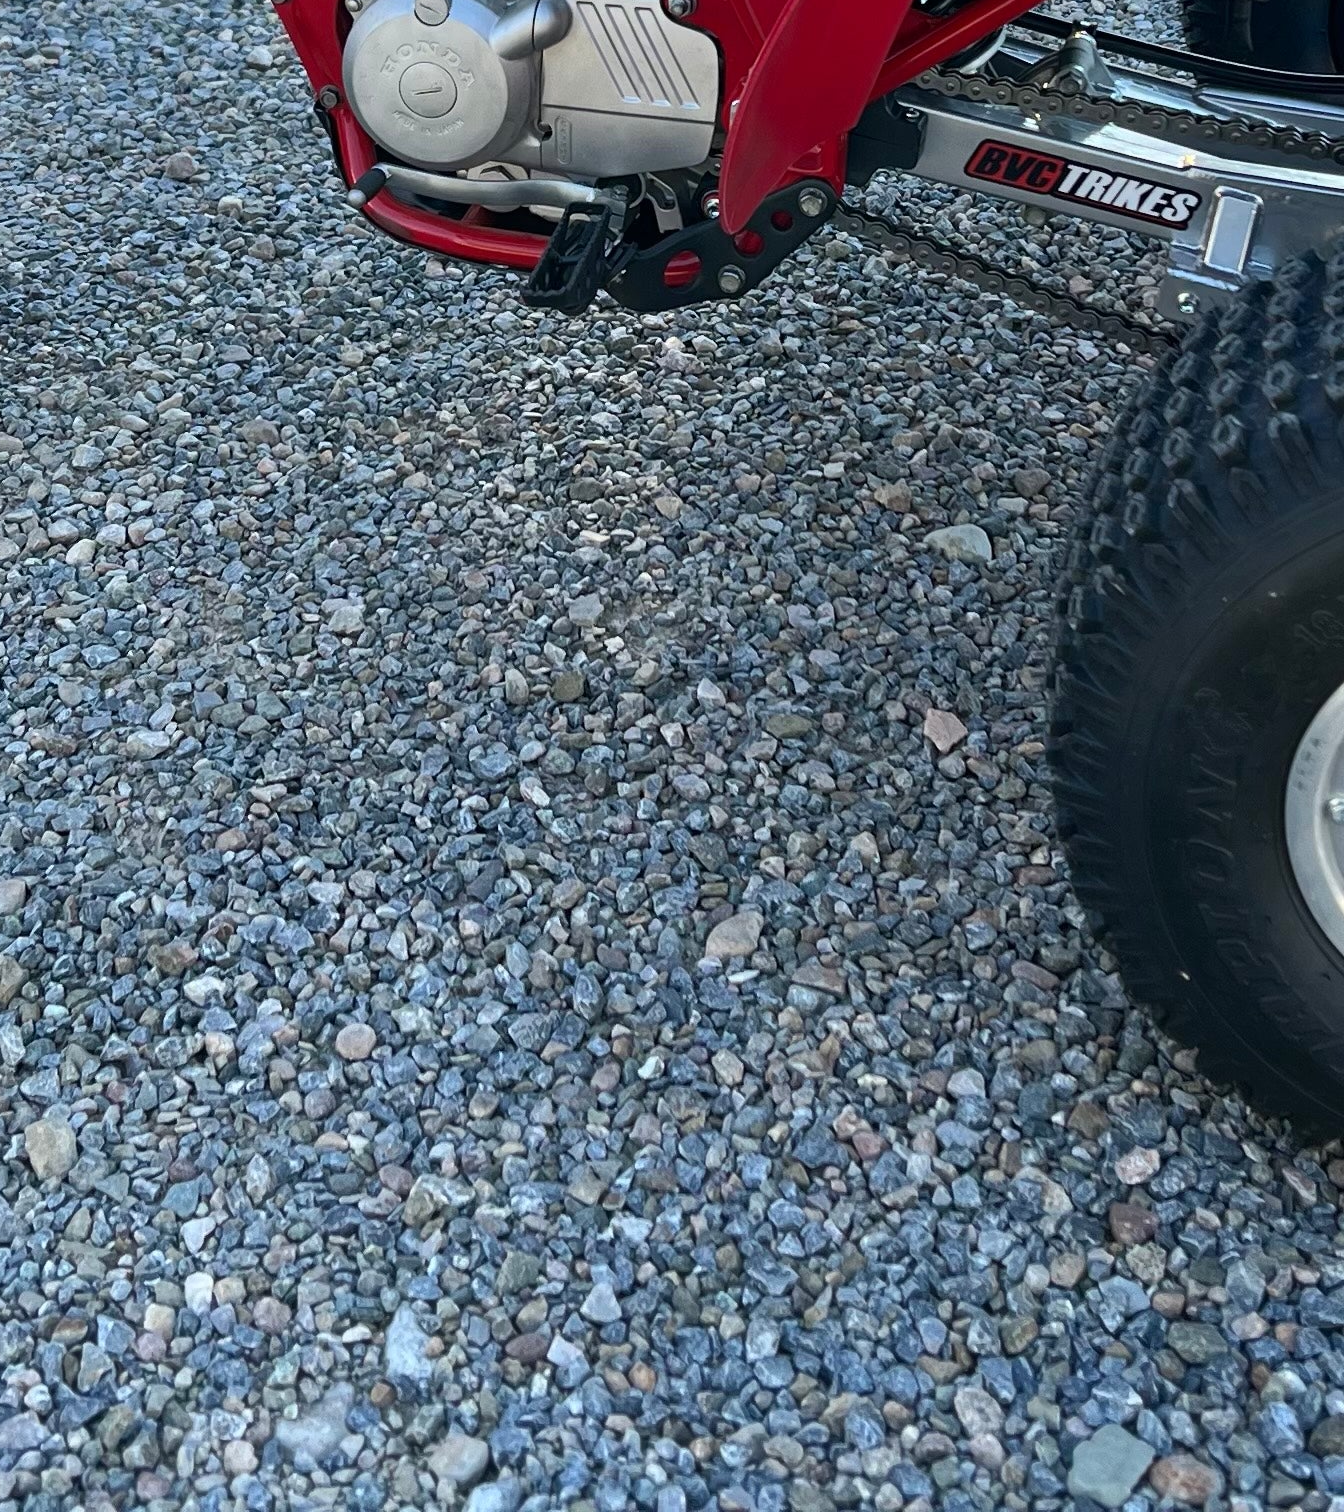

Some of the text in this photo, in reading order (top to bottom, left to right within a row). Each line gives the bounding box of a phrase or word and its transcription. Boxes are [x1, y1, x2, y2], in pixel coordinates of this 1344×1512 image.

[379, 40, 476, 90] HONDA
[973, 146, 1200, 223] BVC TRIKES
